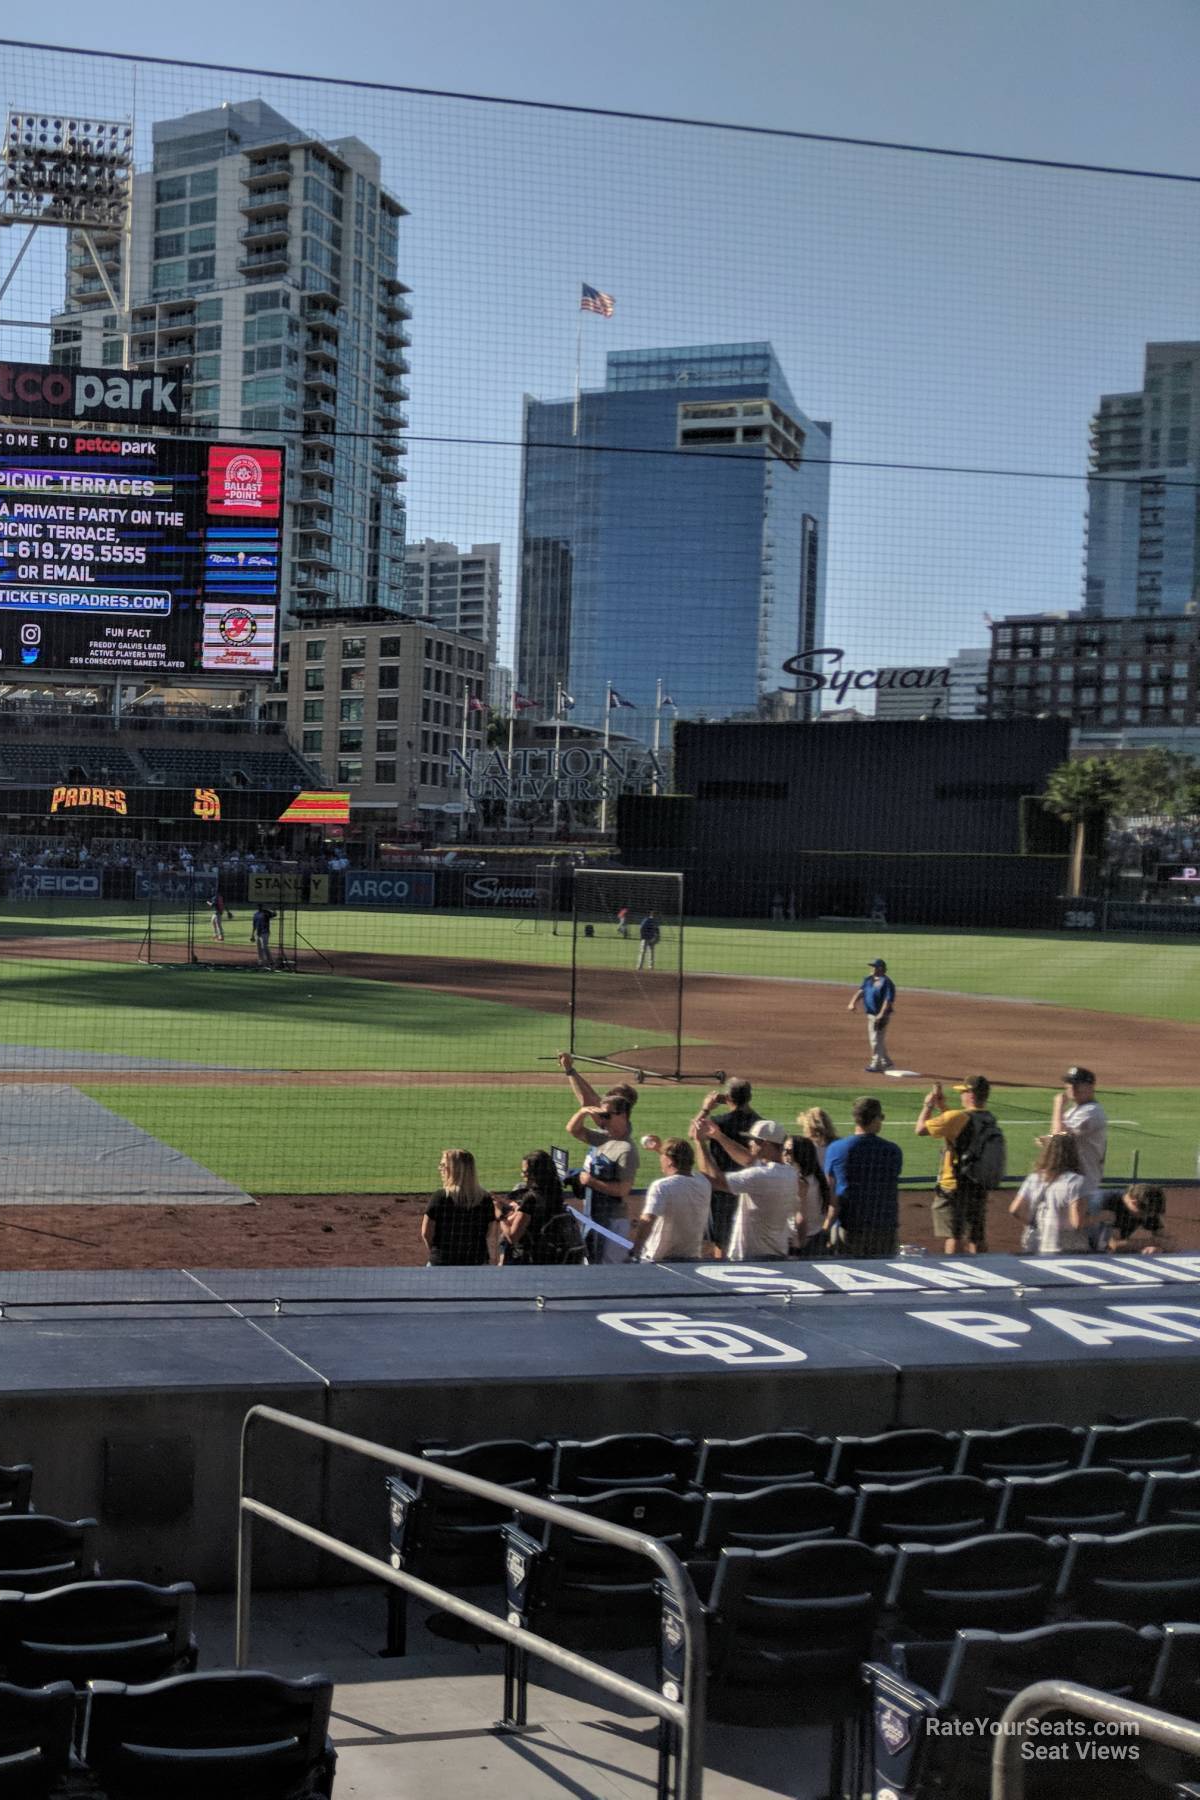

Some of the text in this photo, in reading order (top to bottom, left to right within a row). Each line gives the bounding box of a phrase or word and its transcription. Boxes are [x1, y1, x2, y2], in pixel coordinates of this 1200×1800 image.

[48, 437, 68, 448] TO
[59, 476, 155, 497] TERRACES
[224, 482, 263, 492] BALLAST
[230, 491, 257, 500] POINT
[0, 503, 10, 516] A
[14, 504, 75, 521] PRIVATE
[79, 507, 127, 522] PARTY
[131, 510, 152, 525] ON
[155, 511, 184, 527] THE
[47, 524, 120, 543] TERRACE,
[18, 541, 146, 564] 619.795.5555
[18, 564, 95, 582] OR EMAIL
[105, 628, 151, 638] FUN FACT
[89, 641, 166, 651] FREDDY GALVIS LEADS
[85, 658, 133, 667] CONSECUTIVE
[134, 659, 157, 667] GAMES
[159, 660, 185, 668] PLAYED
[115, 651, 146, 659] PLAYERS
[148, 652, 165, 660] WITH
[778, 648, 957, 704] Sycuan
[447, 746, 666, 778] NATIONA
[50, 786, 128, 816] PADRES
[254, 877, 323, 890] STANLY
[349, 880, 409, 897] ARCO
[473, 877, 540, 903] Sycuan
[695, 1261, 1021, 1297] SAN
